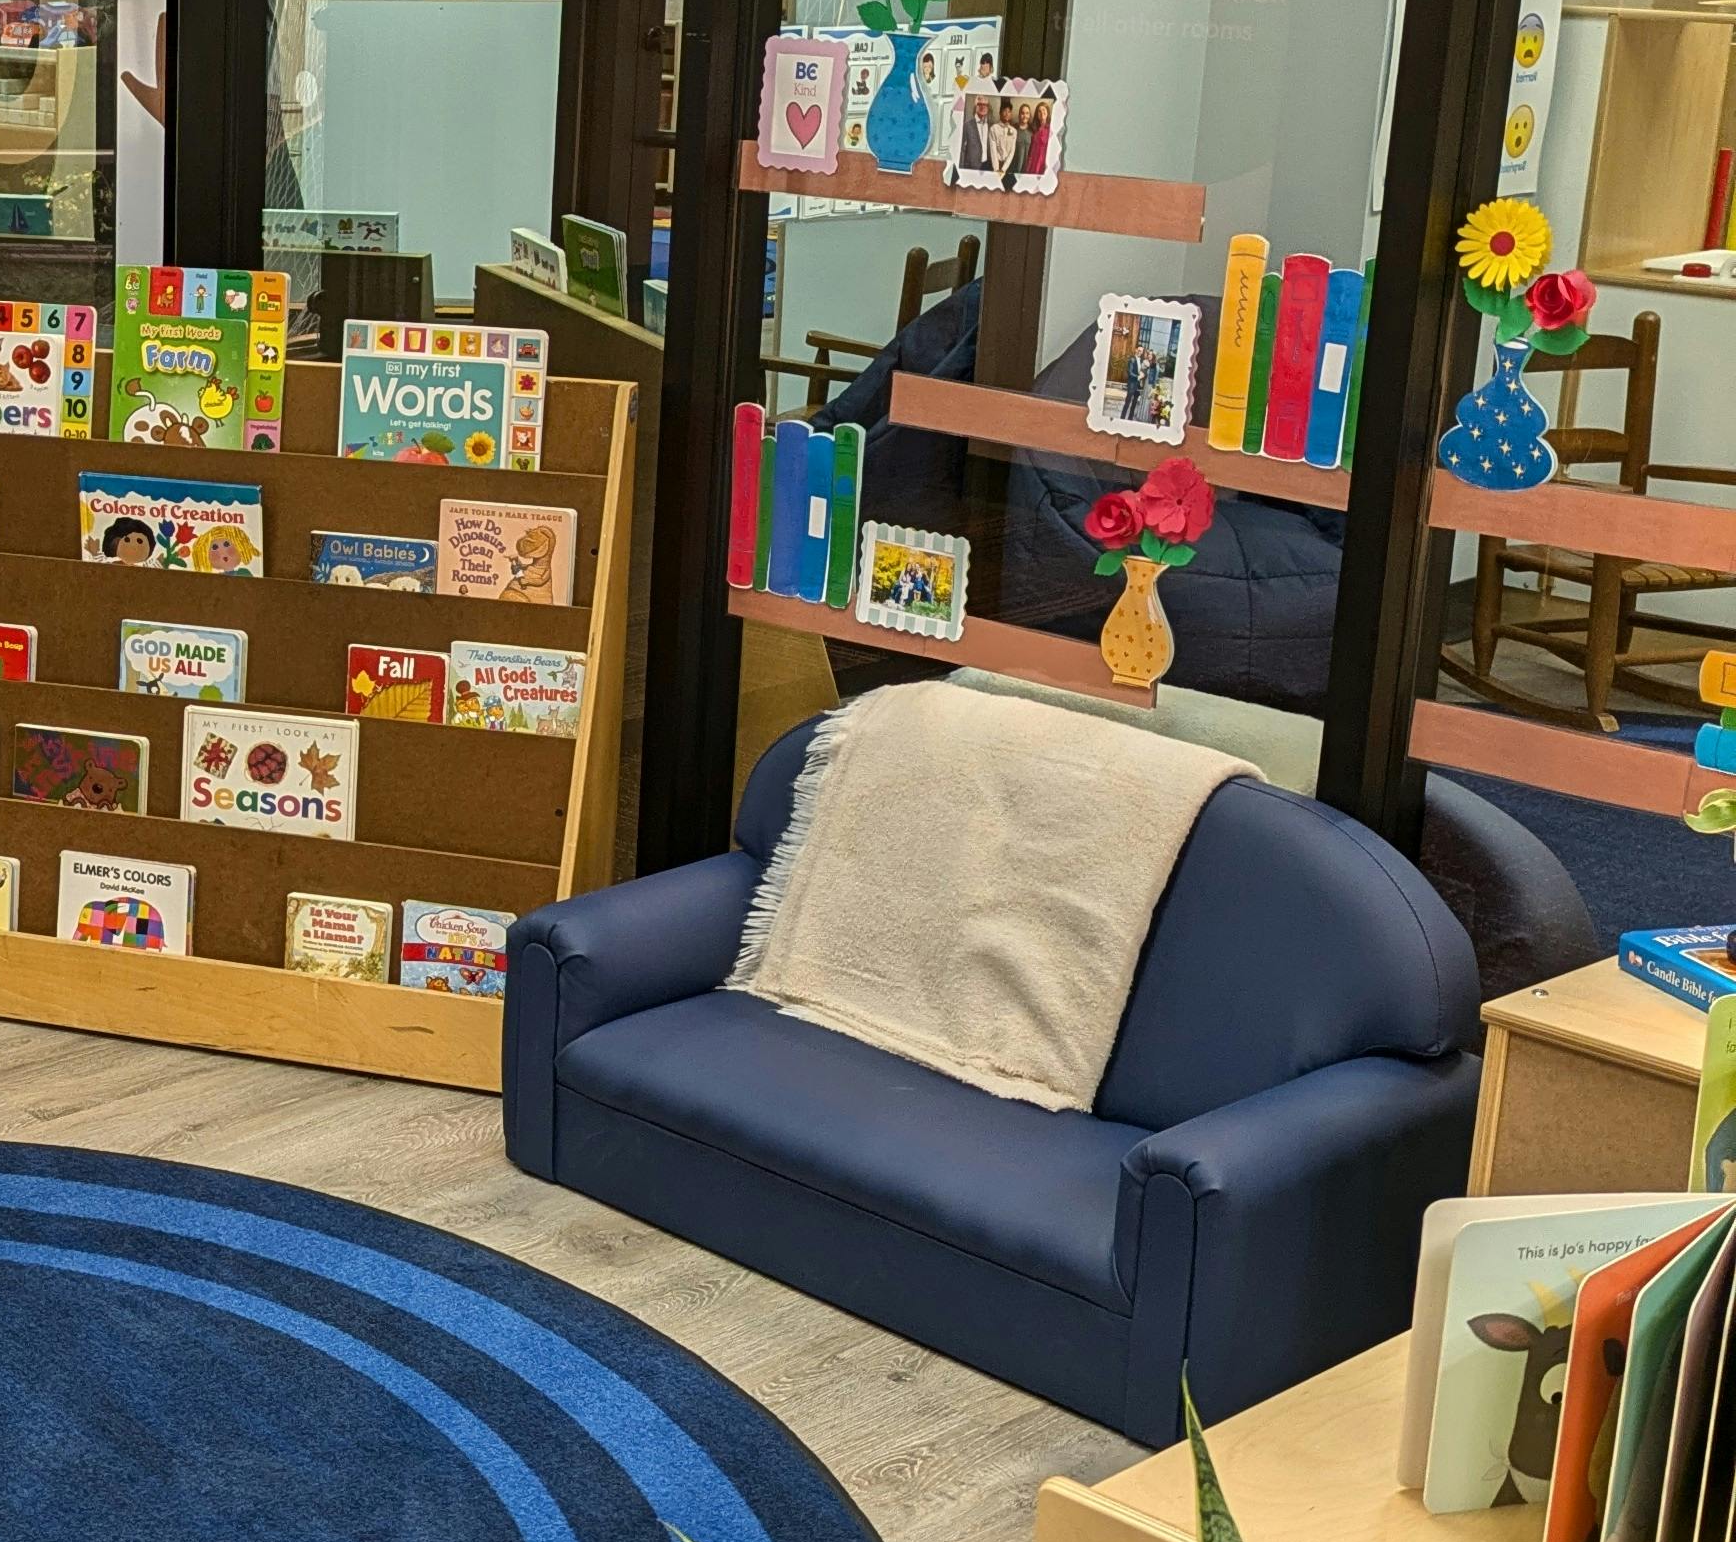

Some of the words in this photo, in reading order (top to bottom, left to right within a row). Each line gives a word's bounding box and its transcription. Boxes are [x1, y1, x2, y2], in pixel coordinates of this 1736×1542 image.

[795, 62, 819, 81] BE
[794, 82, 817, 97] Kind
[20, 308, 34, 328] 5
[47, 309, 61, 329] 6
[74, 312, 87, 332] 7
[141, 324, 158, 339] My
[185, 325, 222, 341] Words
[71, 344, 86, 364] 8
[145, 344, 214, 373] Farm
[70, 371, 84, 391] 9
[387, 363, 402, 373] DK
[406, 364, 430, 379] my
[432, 363, 461, 378] first
[352, 373, 494, 421] Words
[65, 397, 87, 419] 10
[390, 419, 407, 428] Let's
[408, 421, 422, 430] get
[423, 420, 452, 431] talking!
[90, 498, 146, 517] Colors
[149, 504, 168, 518] of
[170, 505, 245, 525] Creation
[455, 517, 482, 532] How
[484, 518, 503, 536] Do
[329, 539, 359, 557] Owl
[363, 543, 417, 561] Babies
[448, 529, 508, 554] Dinosaurs
[459, 544, 495, 560] Clean
[460, 558, 493, 574] Their
[450, 569, 500, 587] Rooms?
[4, 640, 25, 652] Soup
[130, 638, 172, 657] GOD
[175, 642, 227, 664] MADE
[148, 656, 172, 674] US
[174, 660, 208, 678] ALL
[466, 648, 484, 661] The
[484, 650, 533, 666] Berenstain
[378, 655, 415, 680] Fall
[474, 666, 496, 685] All
[498, 665, 538, 685] God's
[503, 684, 579, 705] Creatures
[202, 719, 219, 730] MY
[231, 722, 264, 734] FIRST
[276, 727, 310, 739] LOOK
[322, 732, 337, 742] AT
[192, 776, 343, 823] Seasons
[73, 862, 121, 880] ELMER'S
[123, 869, 173, 888] COLORS
[100, 881, 119, 892] David
[120, 884, 146, 895] McKee
[310, 906, 322, 918] Is
[324, 909, 359, 922] Your
[311, 918, 356, 933] Mama
[429, 914, 464, 933] Chicken
[464, 922, 488, 938] Soup
[302, 930, 312, 939] a
[313, 929, 364, 946] Llama?
[426, 945, 496, 968] NATURE
[1646, 960, 1681, 988] Candle
[1682, 977, 1707, 1000] Bible
[1518, 1245, 1545, 1260] This
[1548, 1244, 1559, 1257] is
[1562, 1243, 1585, 1260] Jo's
[1588, 1237, 1633, 1255] happy
